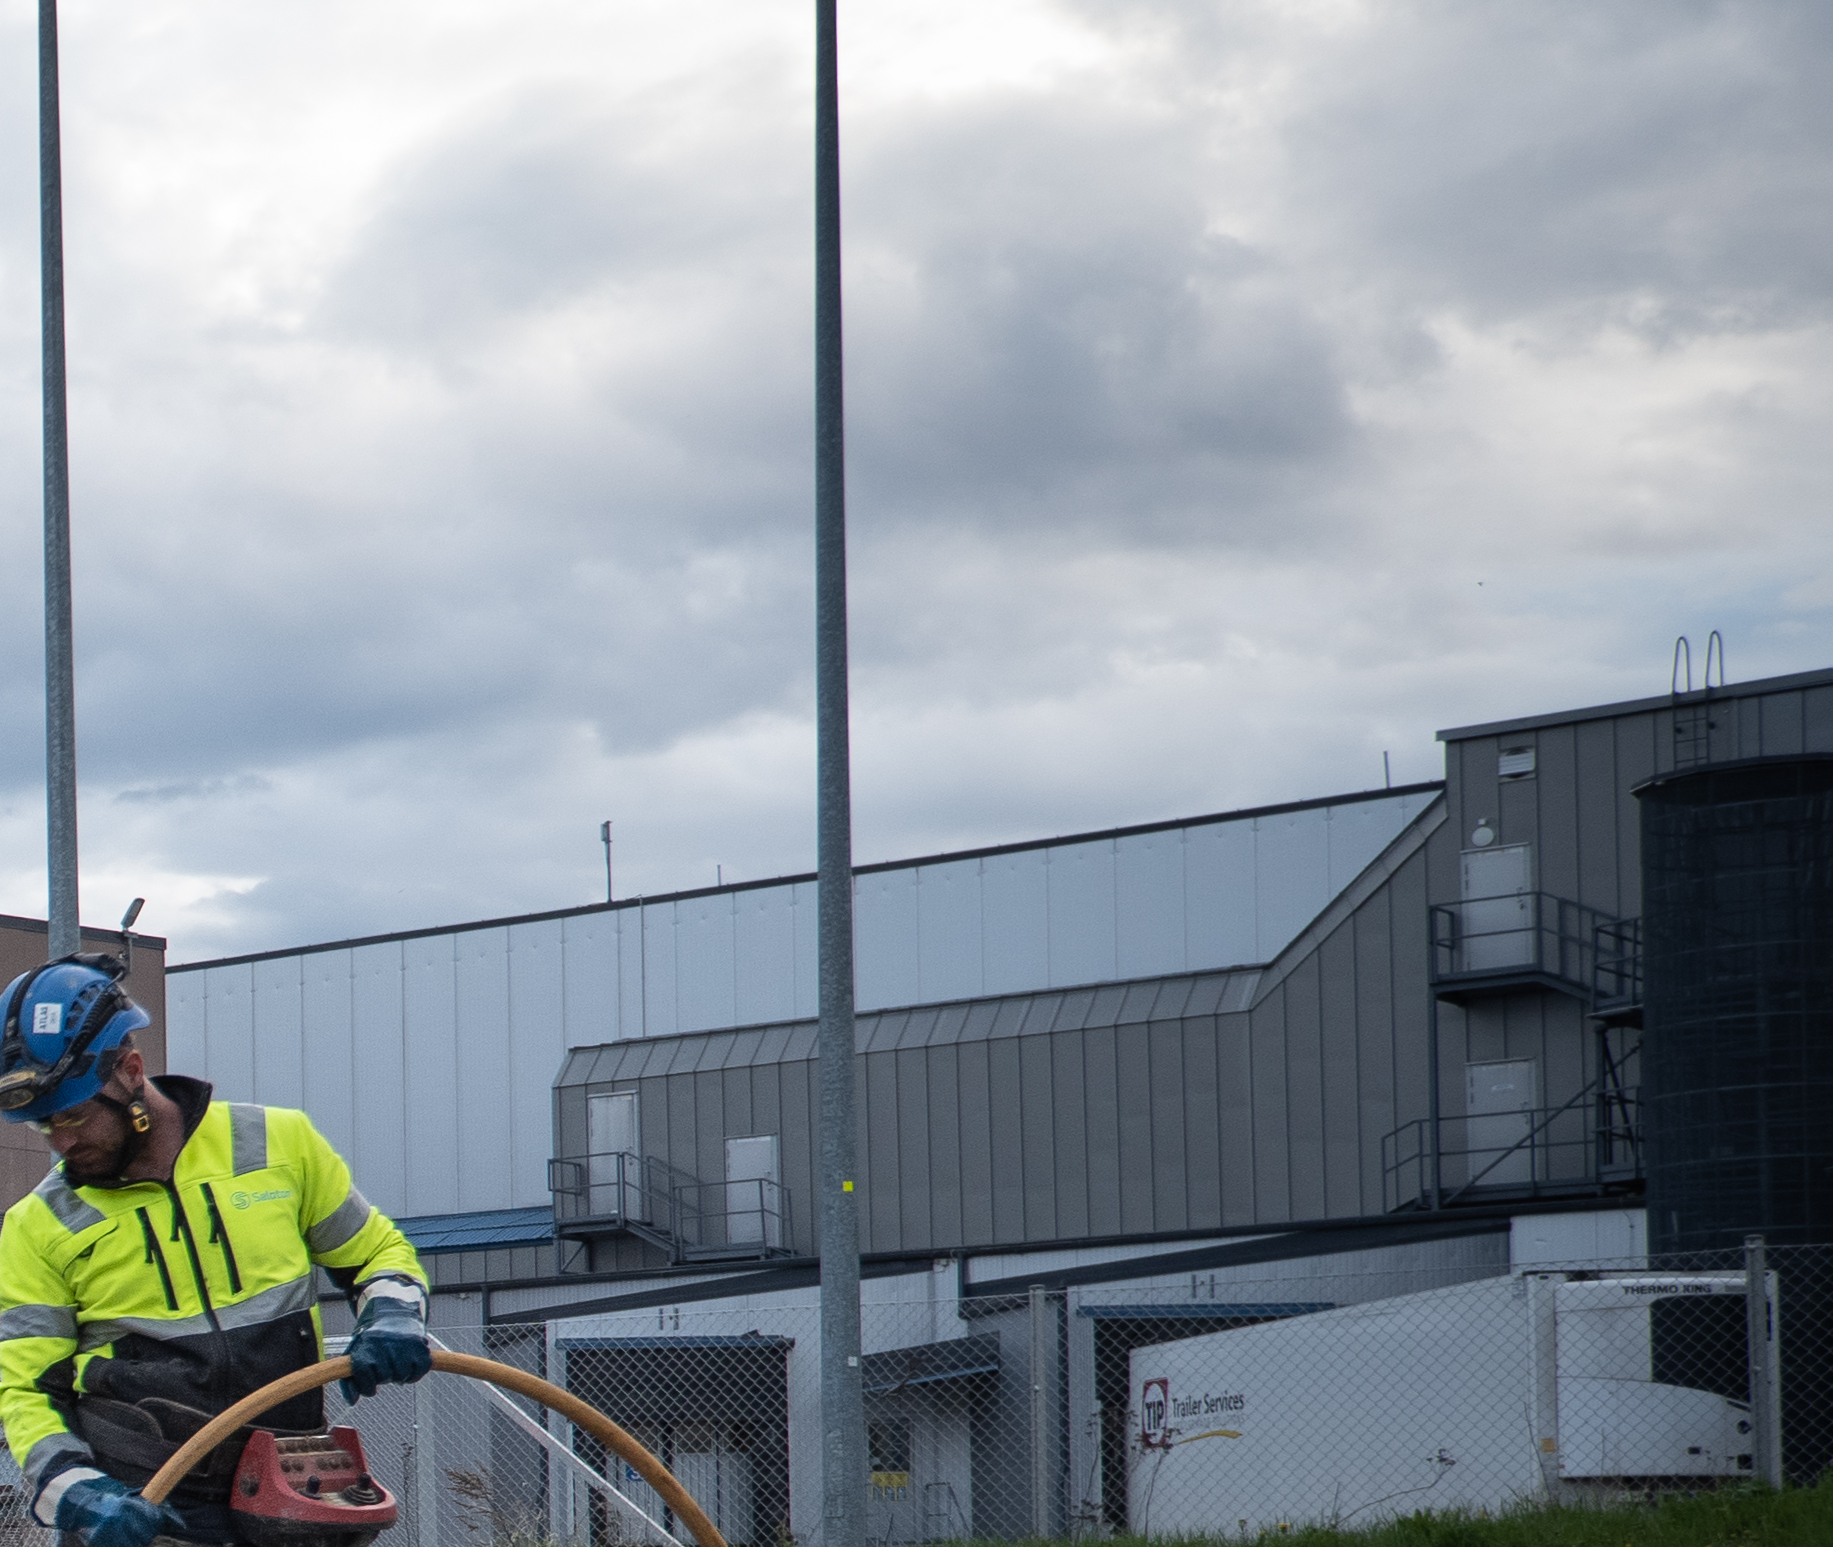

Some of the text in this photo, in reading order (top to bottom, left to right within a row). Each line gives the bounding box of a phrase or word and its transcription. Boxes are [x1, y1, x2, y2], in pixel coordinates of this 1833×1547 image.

[1623, 1284, 1712, 1295] THERMO KING
[1145, 1400, 1165, 1431] TIP
[1171, 1389, 1245, 1418] Trailer Services
